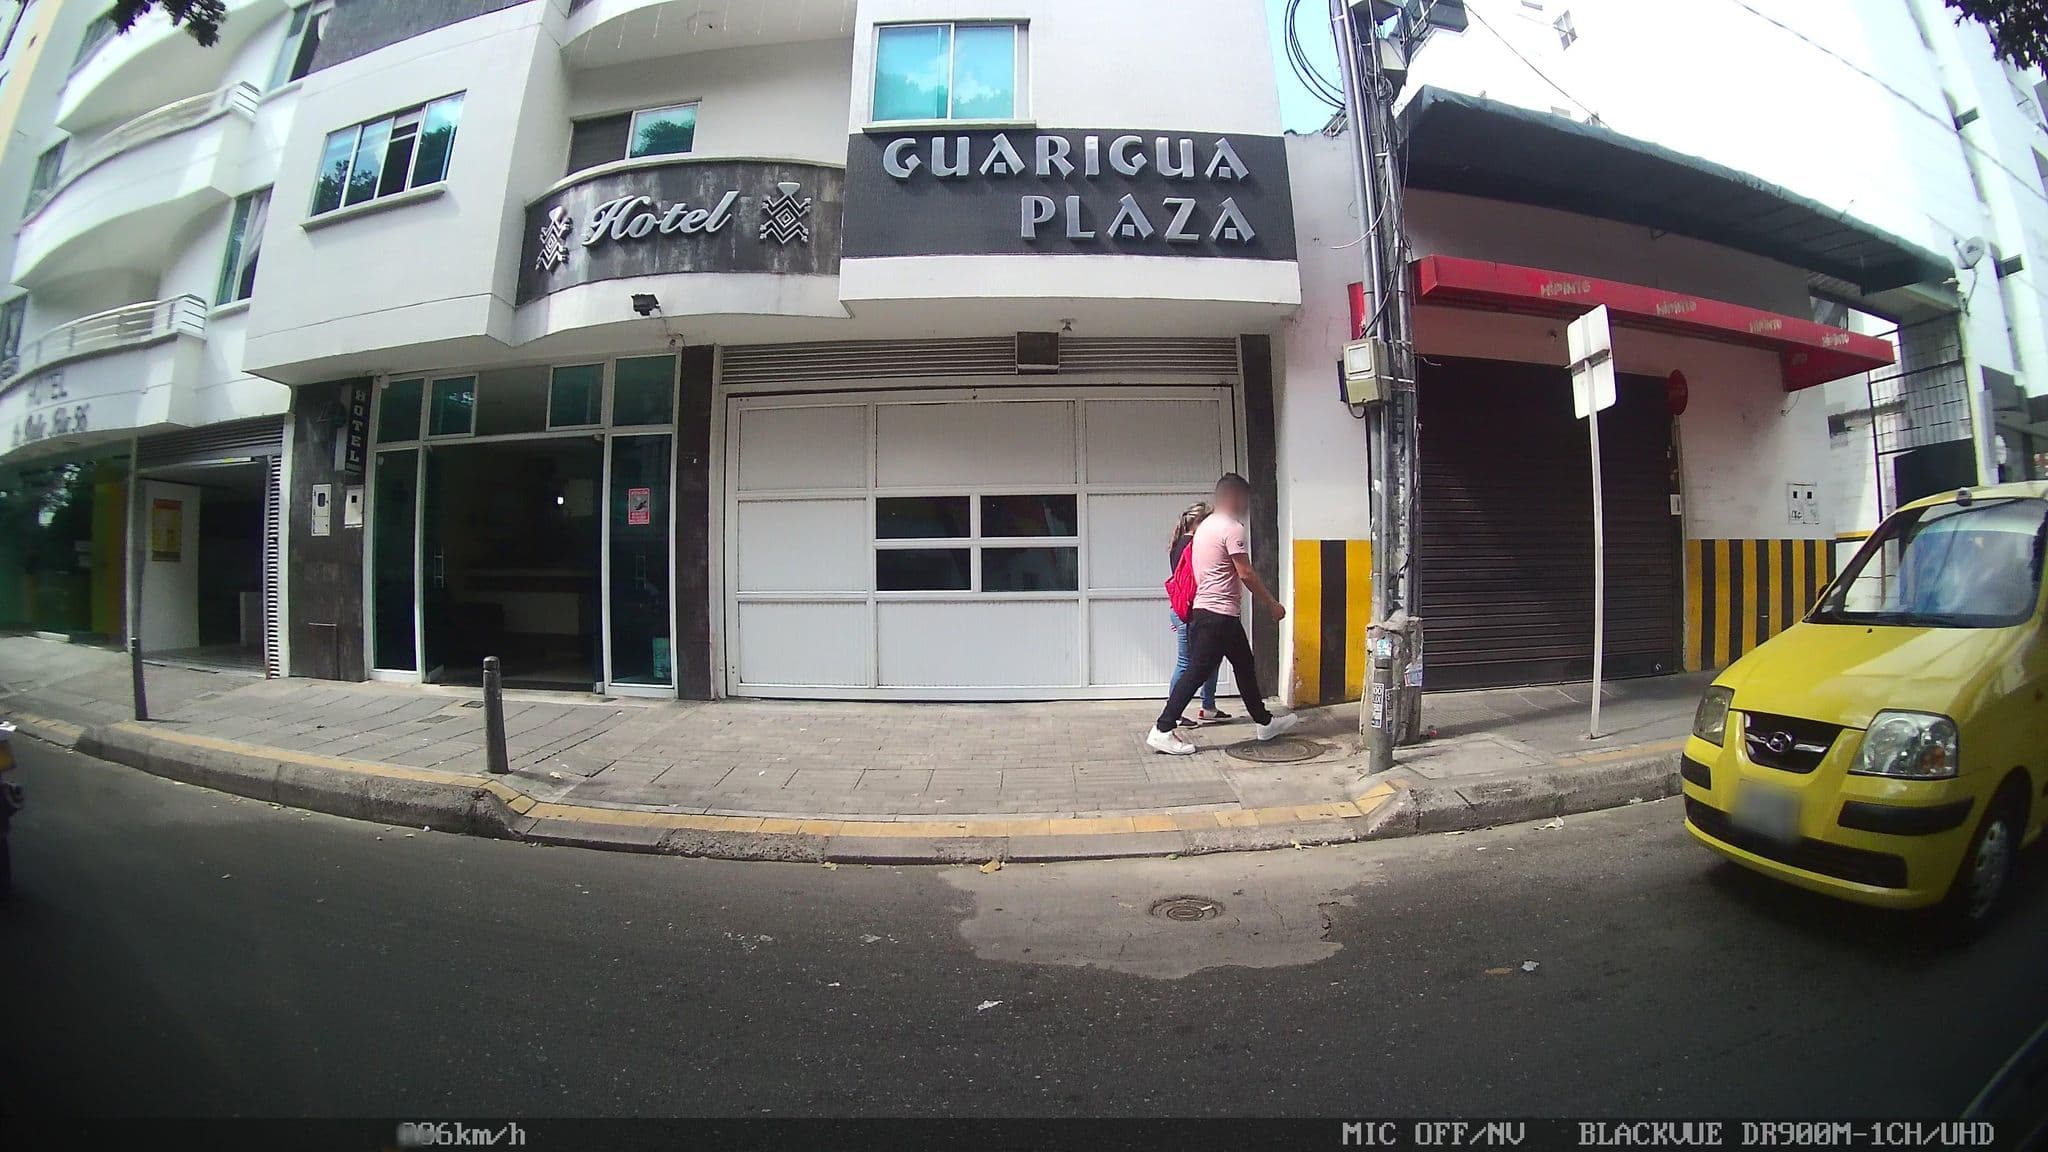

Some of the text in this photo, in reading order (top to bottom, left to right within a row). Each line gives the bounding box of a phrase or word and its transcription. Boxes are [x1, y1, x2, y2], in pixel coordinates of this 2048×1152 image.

[883, 133, 1249, 180] GUARIGUA
[582, 190, 740, 246] Hotel
[1020, 193, 1255, 241] PLAZA
[349, 389, 367, 462] HOTEL
